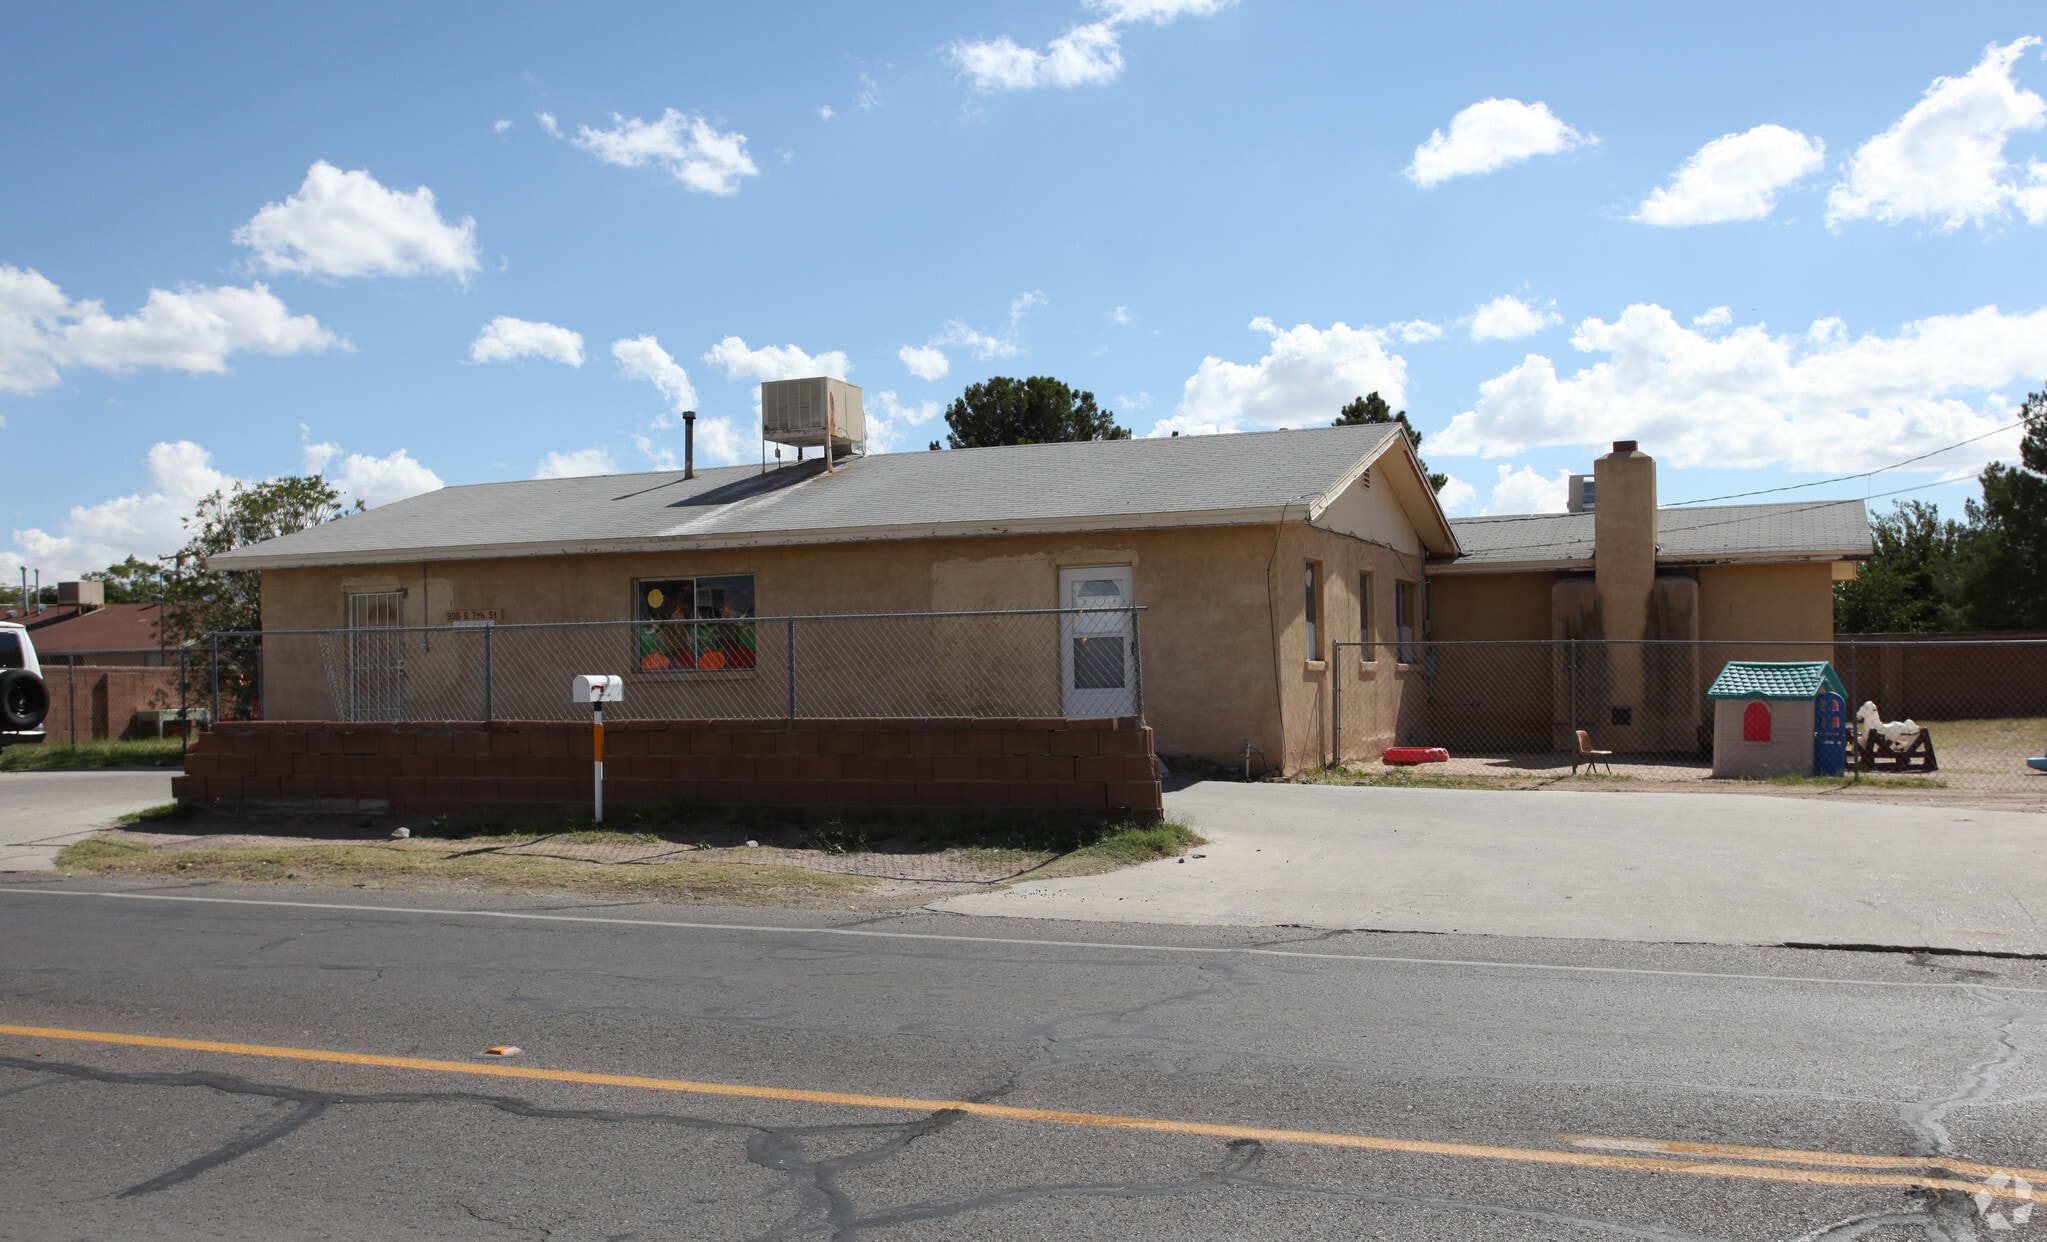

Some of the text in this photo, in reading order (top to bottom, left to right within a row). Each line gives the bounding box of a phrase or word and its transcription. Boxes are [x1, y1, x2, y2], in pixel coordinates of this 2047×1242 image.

[447, 612, 461, 620] 300
[472, 611, 485, 619] 7th
[489, 611, 497, 619] St
